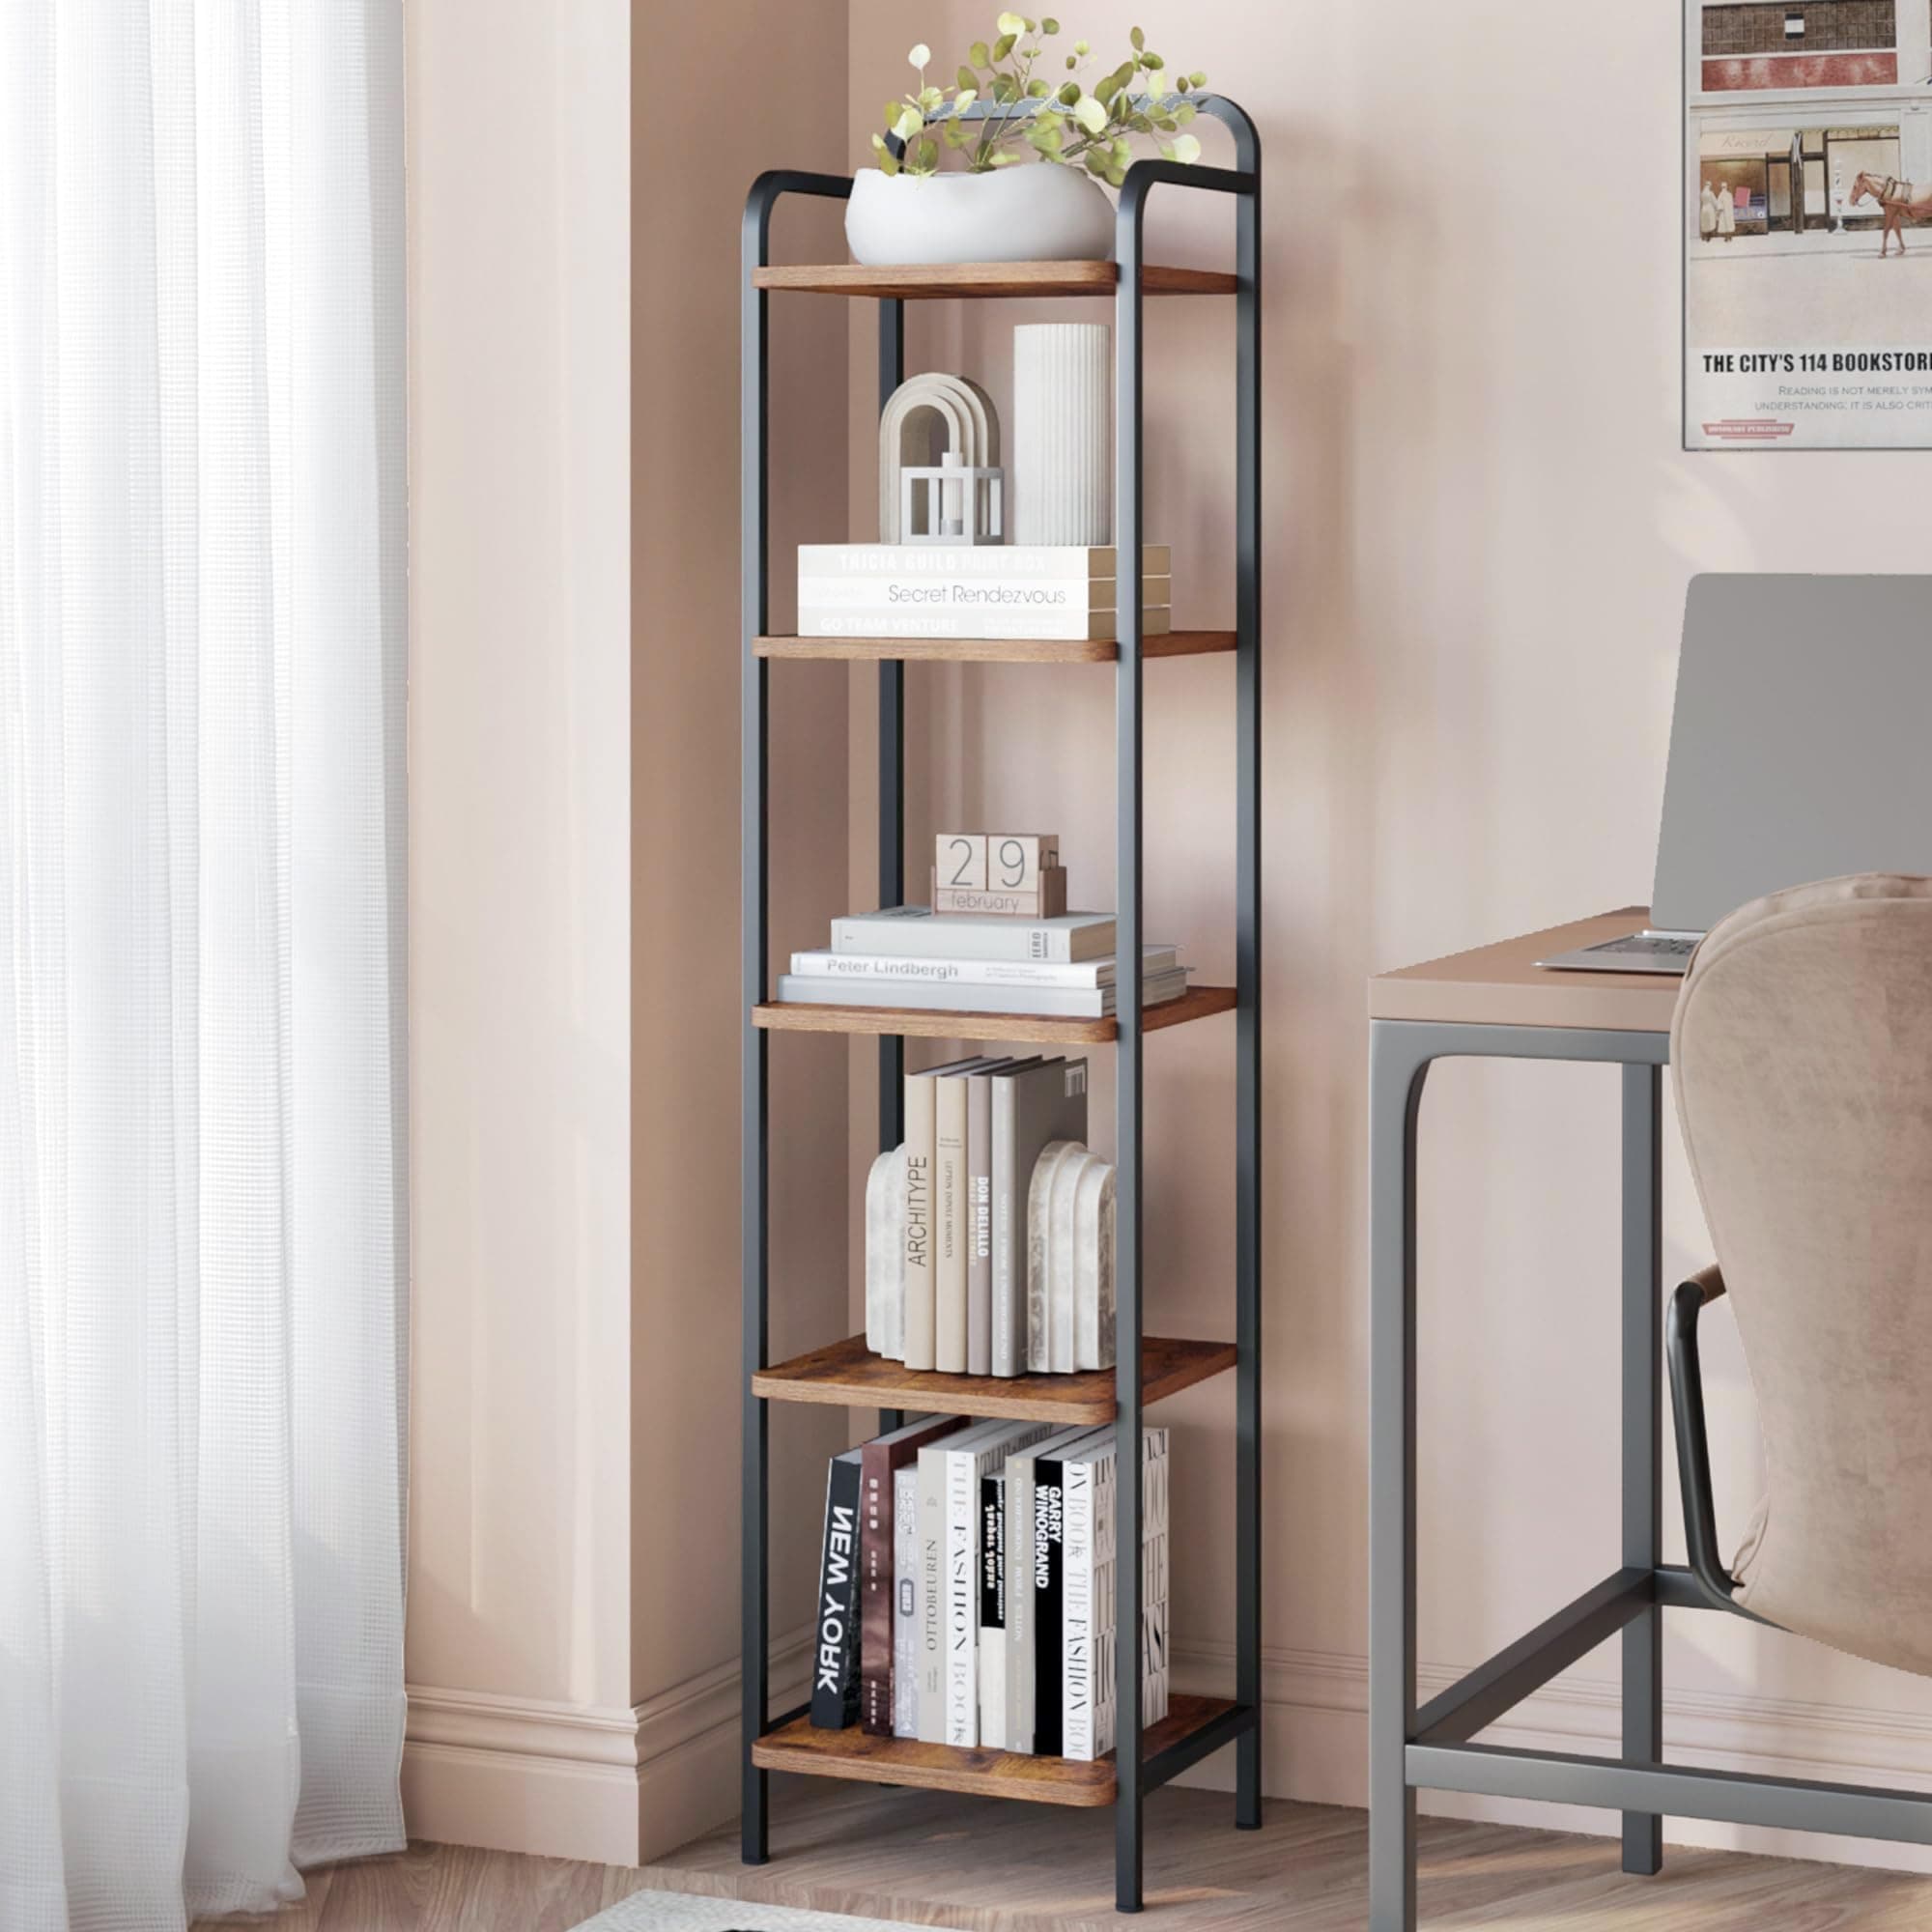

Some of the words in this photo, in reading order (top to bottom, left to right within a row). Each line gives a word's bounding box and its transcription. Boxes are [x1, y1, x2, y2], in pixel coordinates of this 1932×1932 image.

[1702, 355, 1734, 373] THE
[1740, 354, 1795, 373] CITY'S
[1800, 354, 1827, 372] 114
[1830, 386, 1839, 395] IS
[1842, 386, 1864, 395] NOT
[1867, 386, 1910, 395] MERELY
[1850, 402, 1861, 411] IT
[1863, 402, 1873, 411] IS
[1876, 402, 1904, 411] ALSO
[1907, 402, 1932, 411] CRIT
[905, 554, 957, 572] GUILD
[888, 584, 947, 603] Secret
[952, 584, 1066, 605] Rendezvous
[952, 889, 1020, 912] february
[827, 958, 870, 974] Peter
[874, 959, 958, 980] Lindbergh
[908, 1155, 927, 1268] ARCHITYPE
[977, 1176, 989, 1204] DON
[977, 1207, 989, 1257] DELILLO
[953, 1458, 967, 1516] THE
[1035, 1485, 1049, 1588] WINOGRAND
[1048, 1486, 1062, 1543] GARRY
[1068, 1497, 1088, 1557] BOOK
[926, 1539, 937, 1651] OTTOBEUREN
[953, 1524, 967, 1651] FASHION
[1068, 1570, 1088, 1614] THE
[1068, 1618, 1088, 1711] FASHION
[953, 1662, 967, 1744] BOOK
